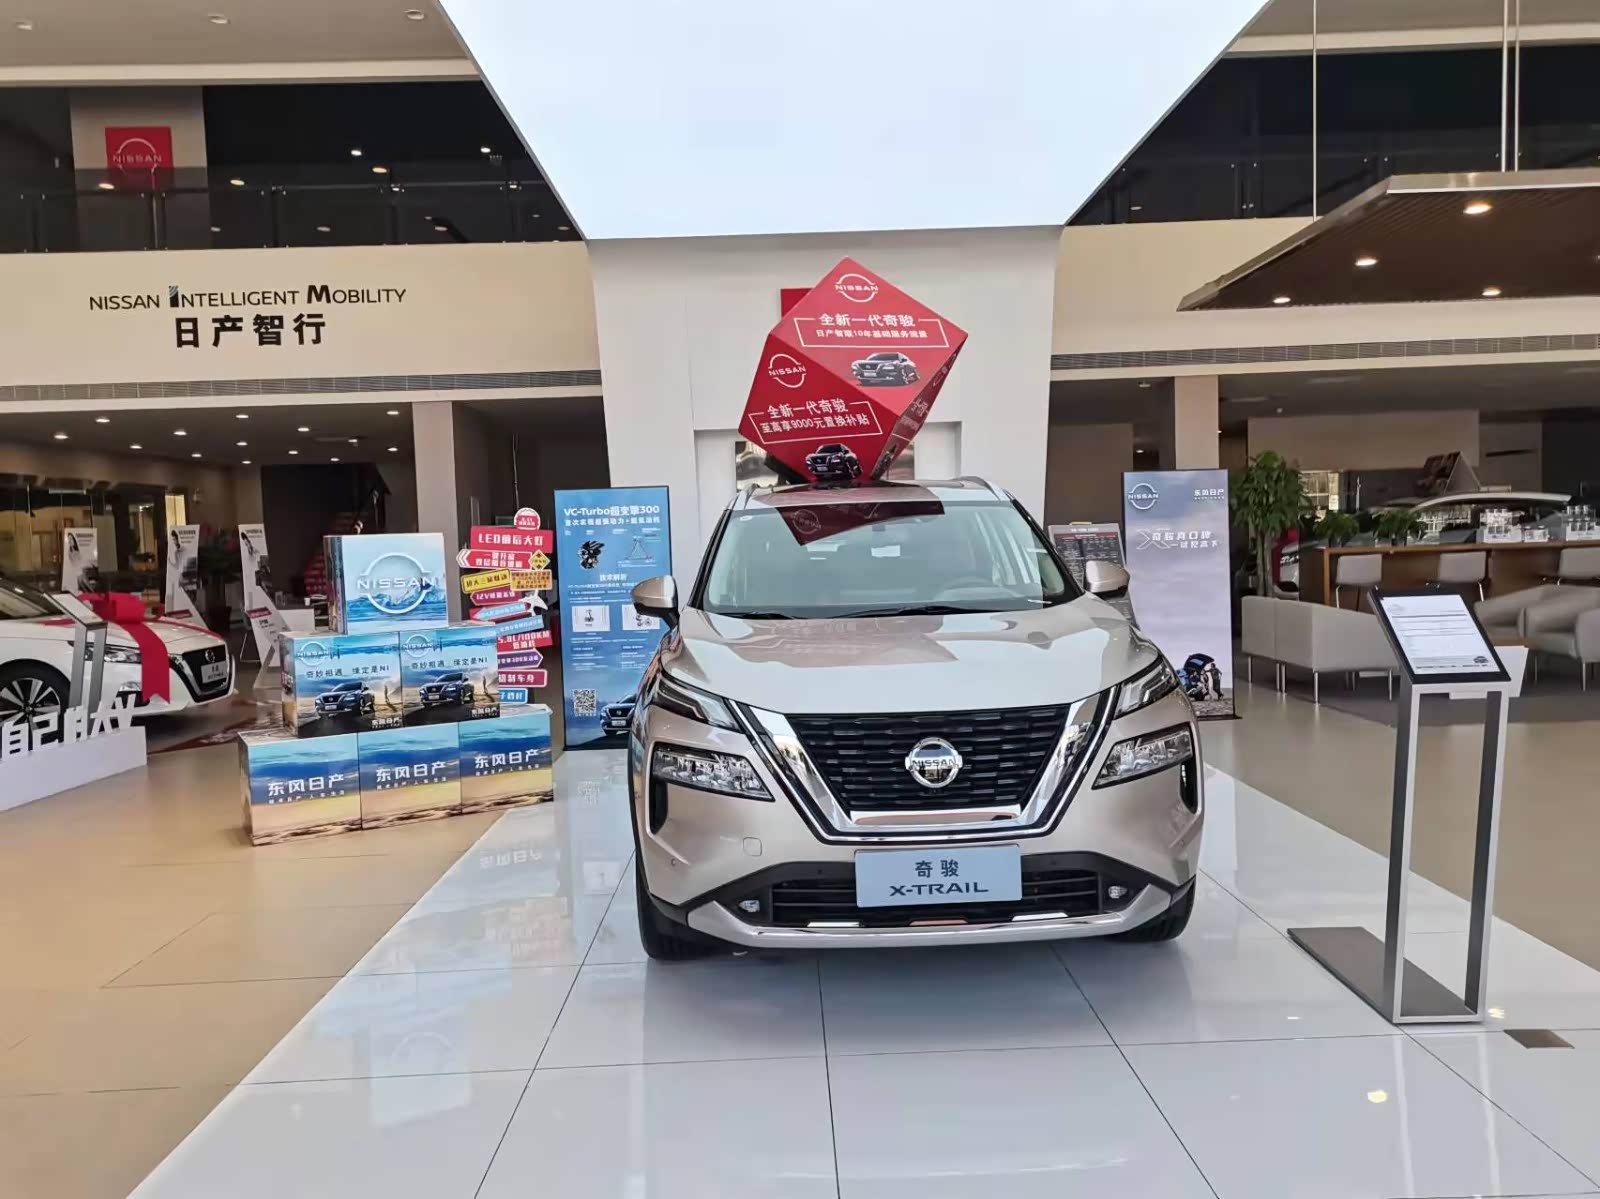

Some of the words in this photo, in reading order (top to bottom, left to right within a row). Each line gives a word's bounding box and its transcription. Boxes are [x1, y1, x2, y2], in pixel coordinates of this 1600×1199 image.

[112, 153, 162, 164] NISSAN
[835, 284, 878, 293] NISSAN
[89, 294, 160, 311] NISSAN
[169, 285, 300, 309] INTELLIGENT
[306, 284, 407, 304] MOBILITY
[818, 313, 916, 327] 全新一代奇骏
[175, 313, 326, 348] 日产智行
[768, 366, 807, 377] NISSAN
[767, 397, 849, 419] 全新一代奇骏
[759, 413, 871, 435] 至高享9000元置换补贴
[1194, 488, 1225, 497] 东风日产
[357, 577, 437, 588] NISSAN
[402, 641, 434, 650] NISSAN
[296, 650, 329, 658] NISSAN
[411, 660, 445, 670] 奇妙相遇
[306, 668, 343, 678] 奇妙相遇
[475, 749, 539, 769] 东风日产
[911, 758, 955, 767] NISSAN
[376, 760, 446, 783] 东风日产
[267, 773, 344, 797] 东风日产
[915, 859, 959, 878] 奇骏
[889, 882, 989, 897] X-TRAIL
